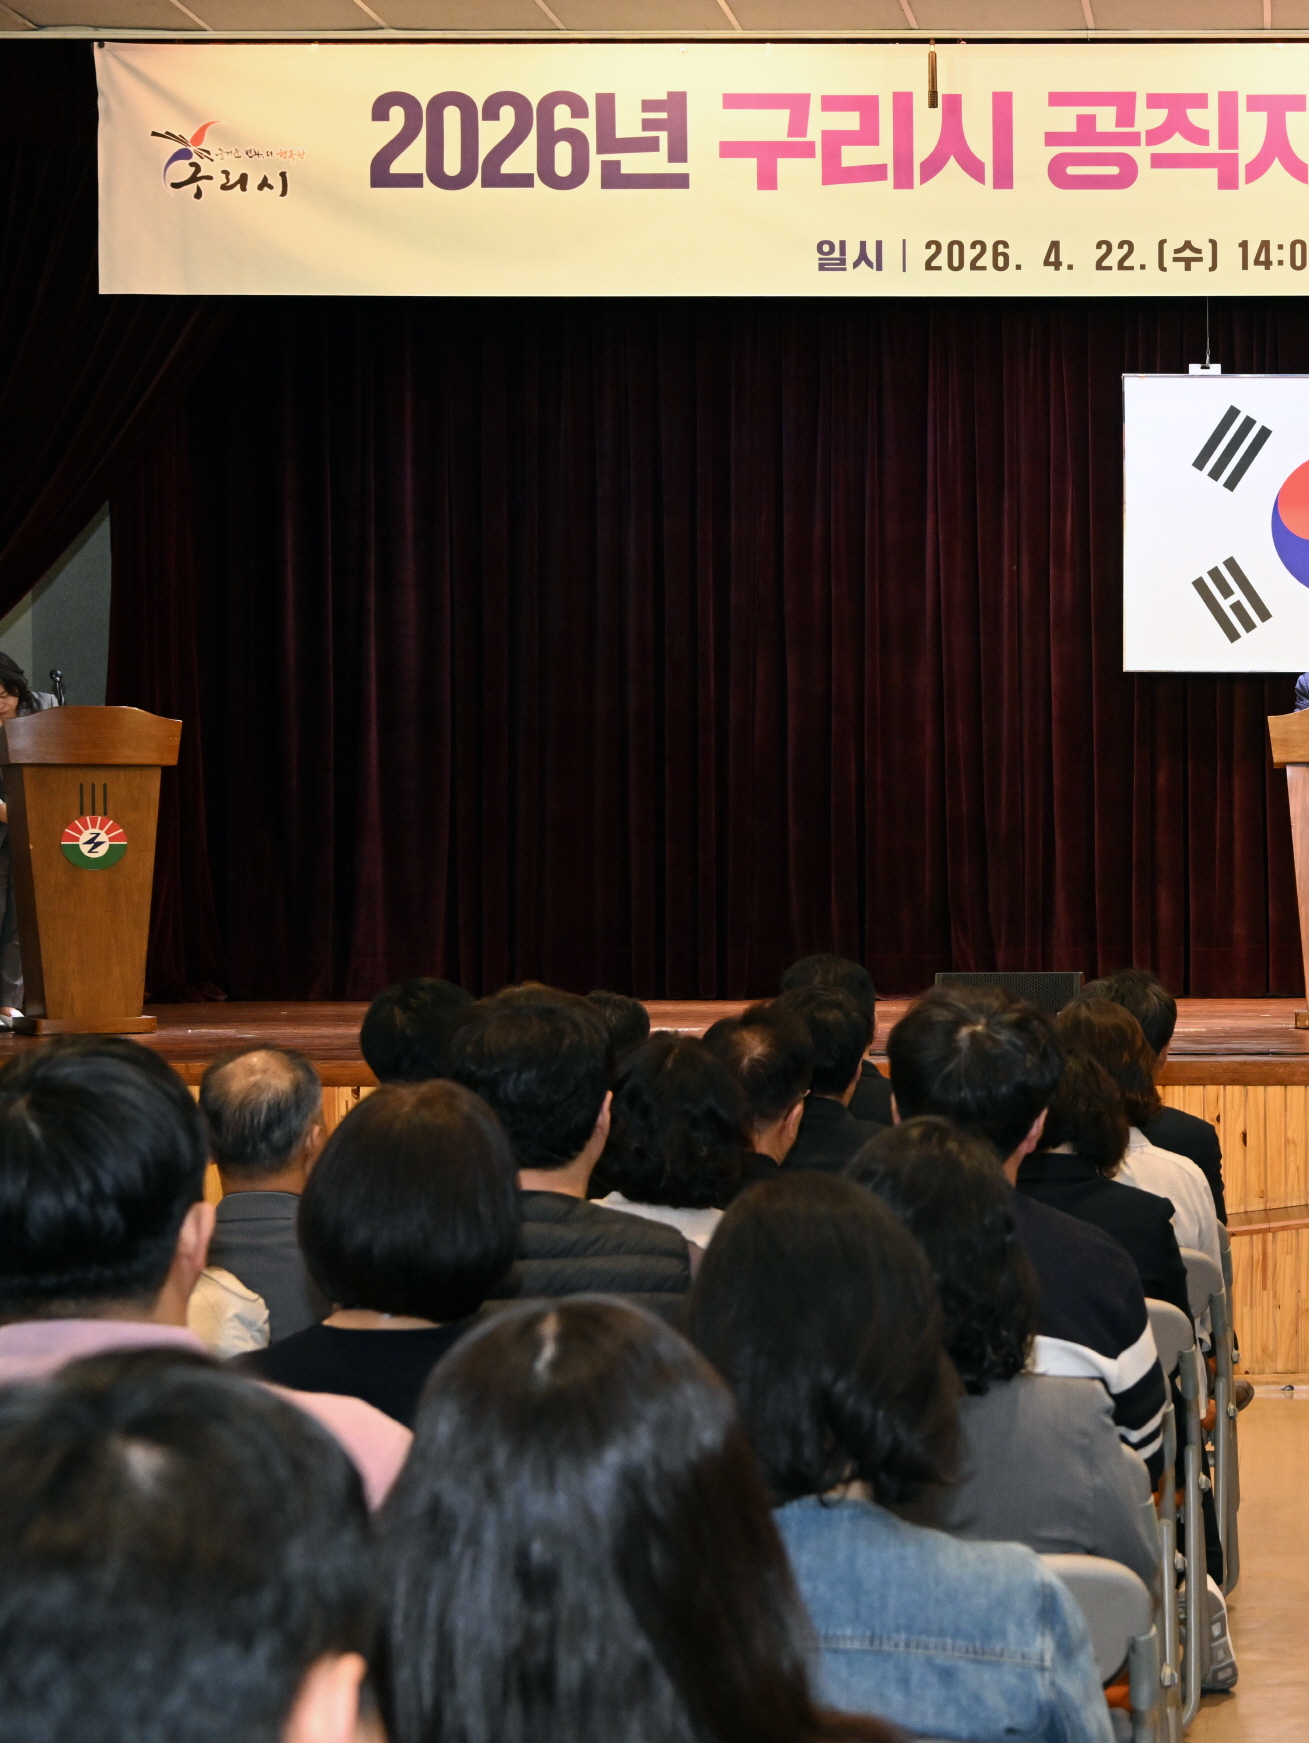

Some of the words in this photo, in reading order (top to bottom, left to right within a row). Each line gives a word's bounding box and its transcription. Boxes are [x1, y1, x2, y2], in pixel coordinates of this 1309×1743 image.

[369, 90, 690, 191] 2026년
[719, 90, 1014, 190] 구리시
[170, 161, 288, 200] 구리시
[816, 239, 883, 272] 일시
[924, 239, 1022, 272] 2026.
[1043, 240, 1074, 272] 4.
